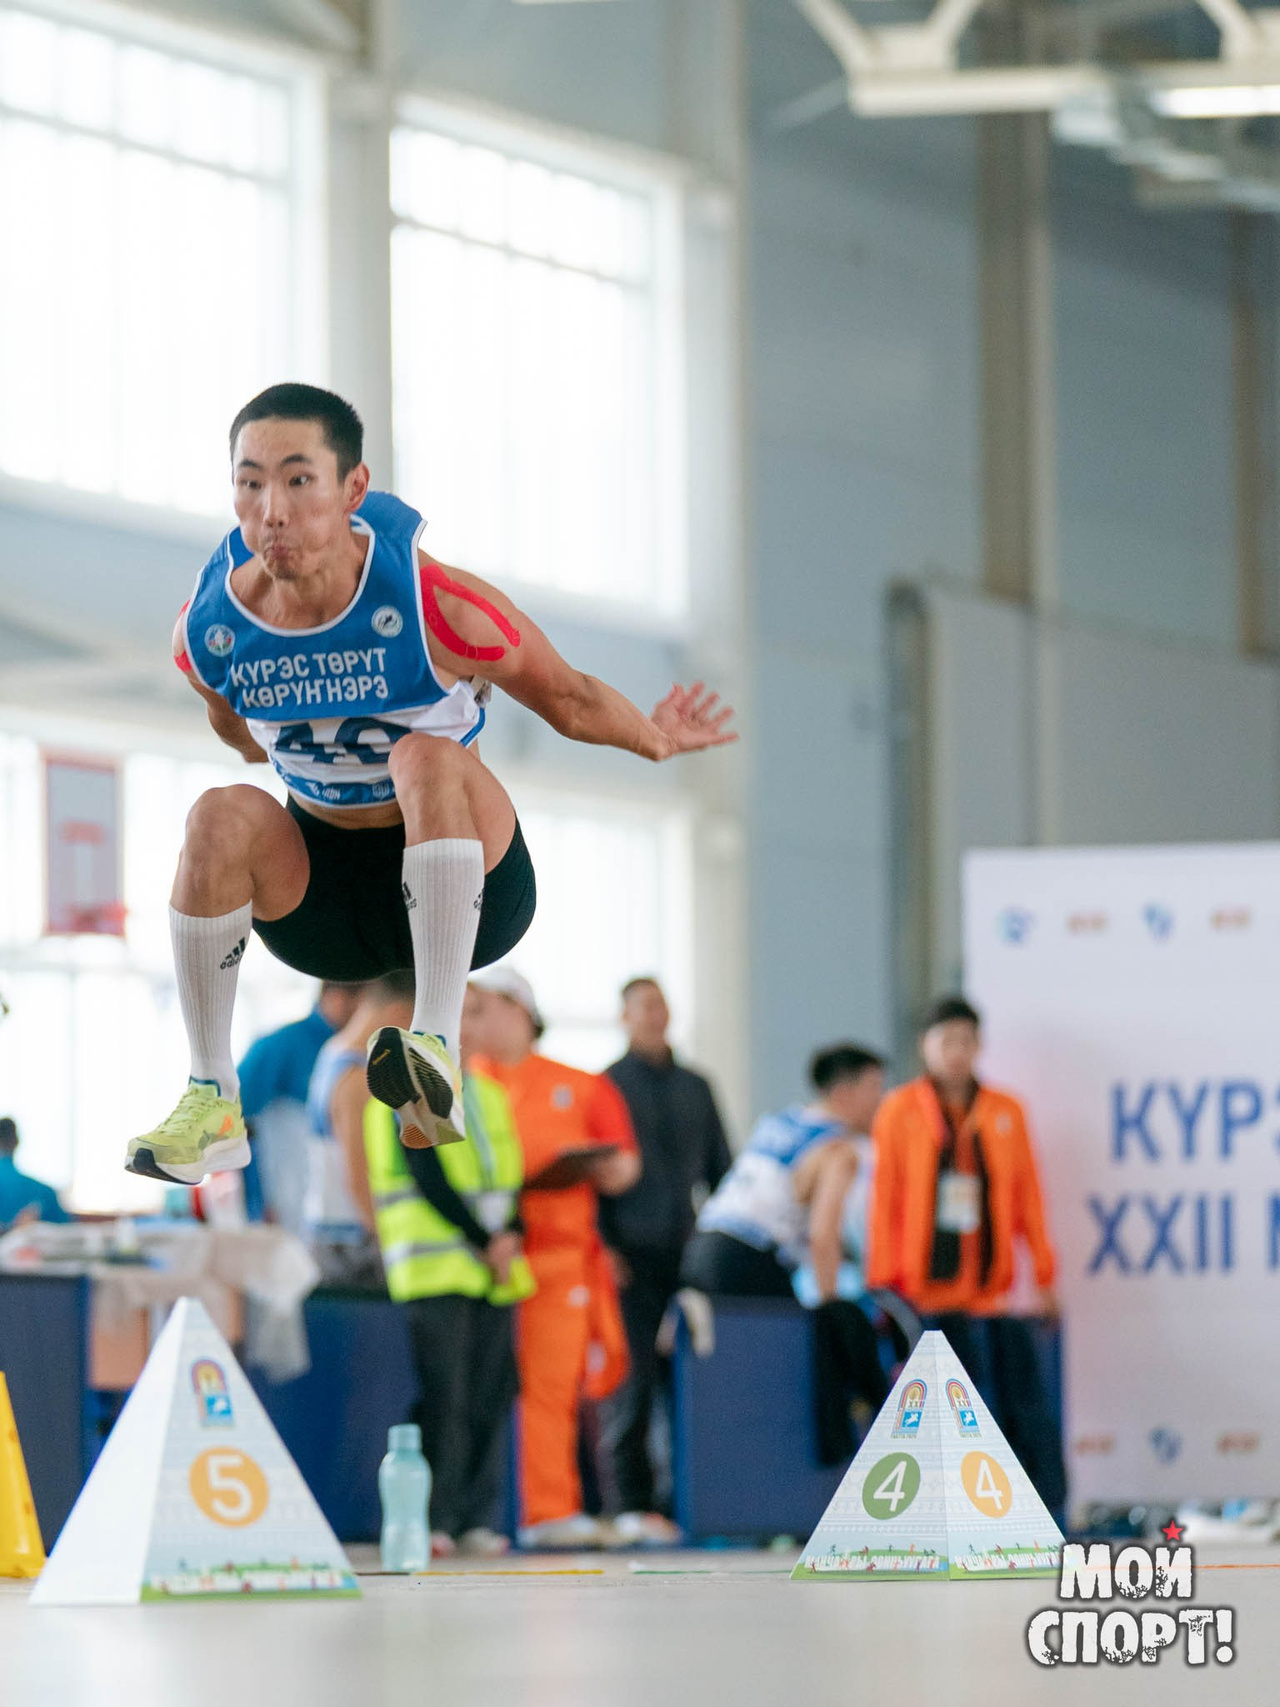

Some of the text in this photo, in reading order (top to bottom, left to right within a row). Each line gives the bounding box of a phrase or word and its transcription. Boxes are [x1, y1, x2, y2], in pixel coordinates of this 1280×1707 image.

[312, 647, 387, 677] ТӨРҮТ
[1111, 1078, 1280, 1164] КҮР
[208, 1453, 253, 1521] 5
[873, 1460, 908, 1512] 4
[976, 1459, 1004, 1511] 4
